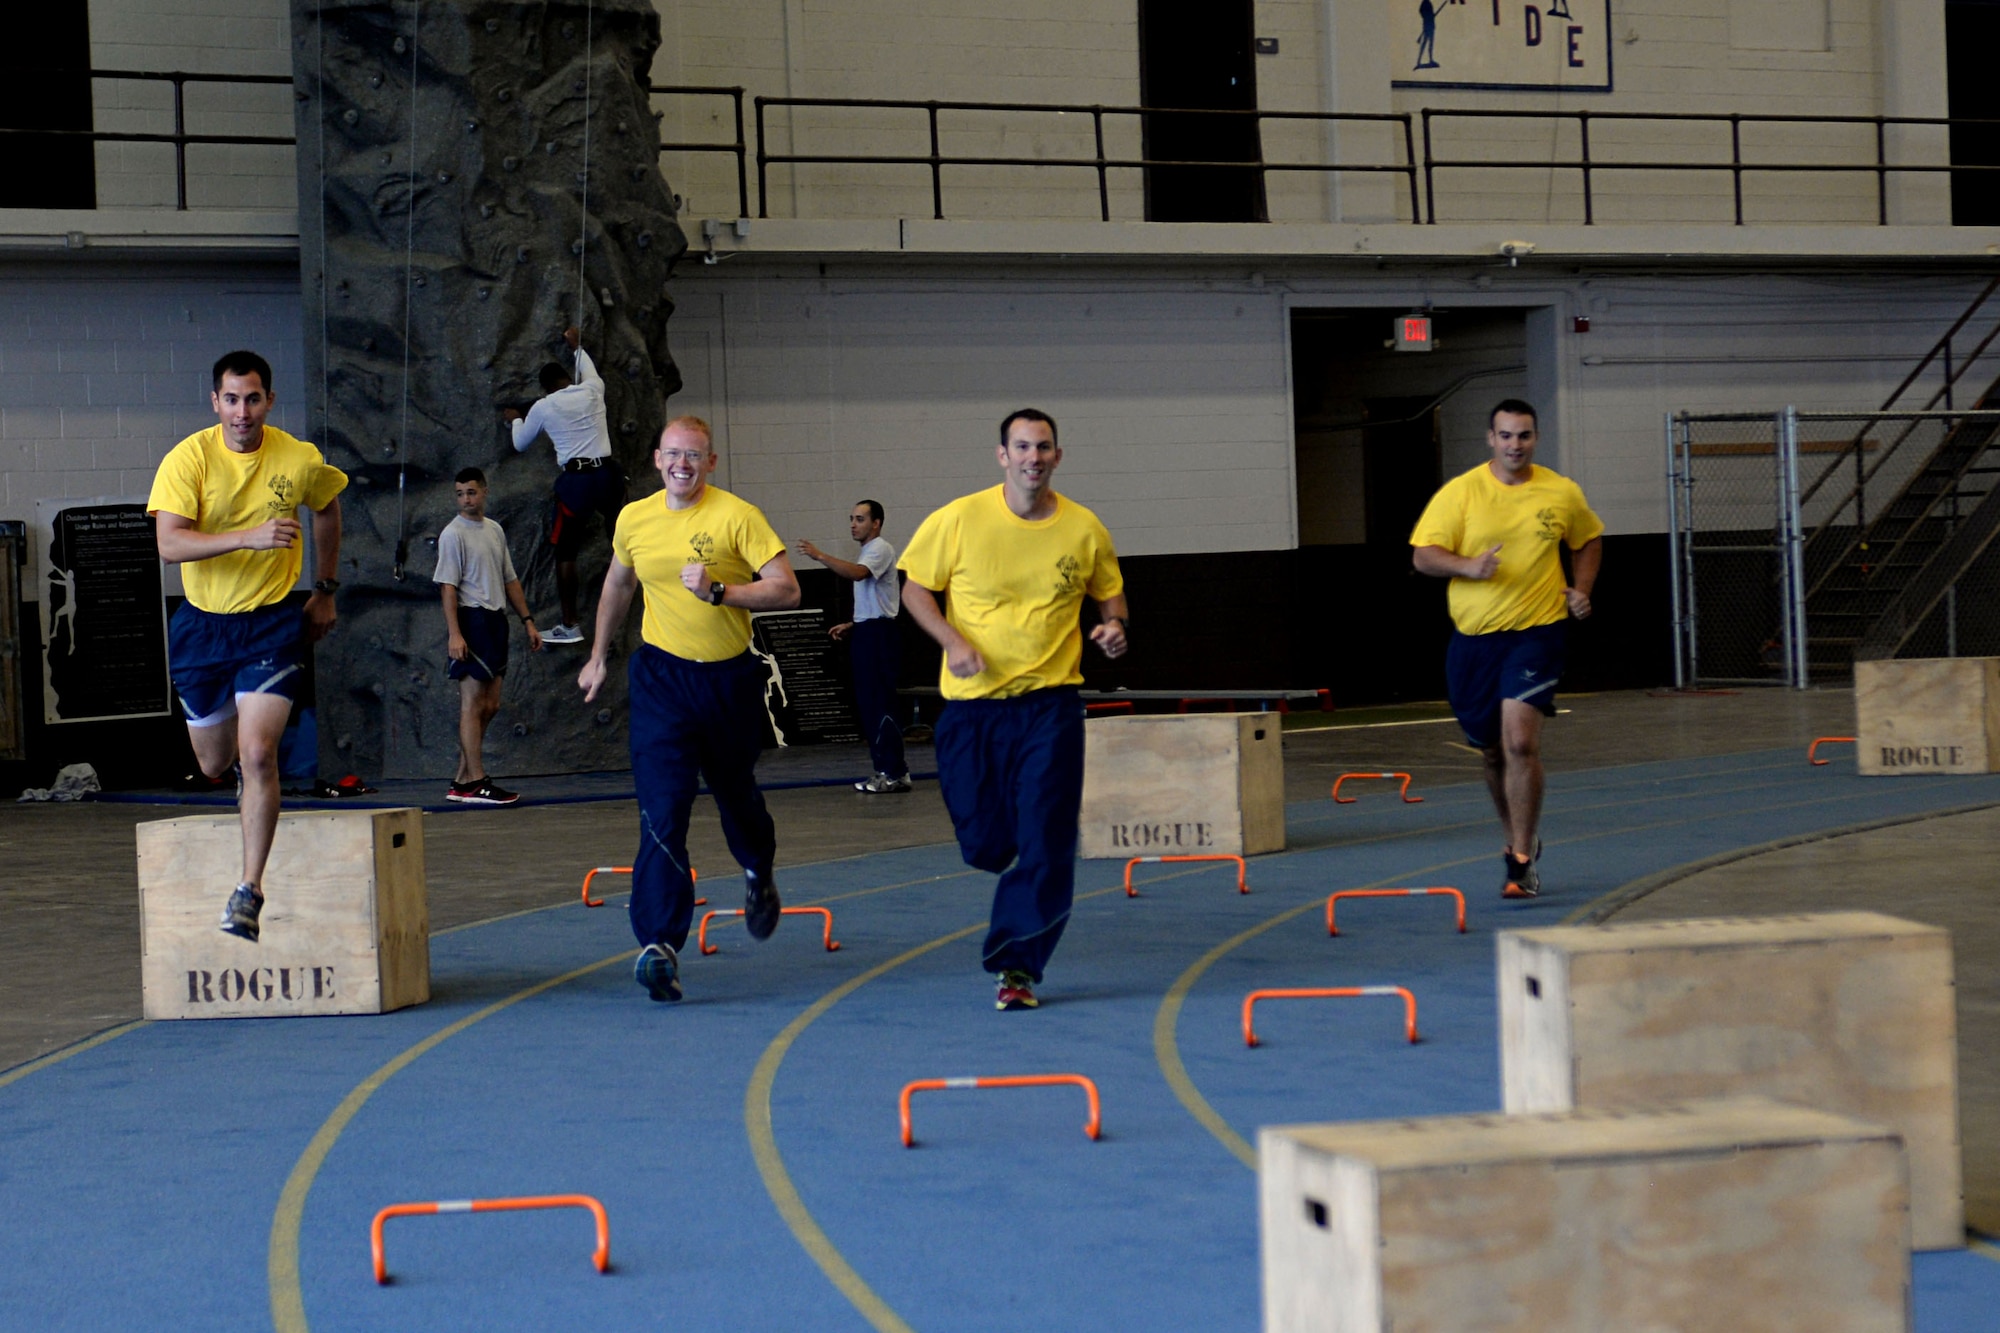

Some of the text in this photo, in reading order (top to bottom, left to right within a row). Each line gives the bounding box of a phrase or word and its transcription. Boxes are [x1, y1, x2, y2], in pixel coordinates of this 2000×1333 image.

[1450, 0, 1584, 68] IDE
[1405, 319, 1427, 341] EXIT
[1881, 746, 1963, 766] ROGUE
[1112, 823, 1213, 847] ROGUE
[187, 966, 335, 1003] ROGUE
